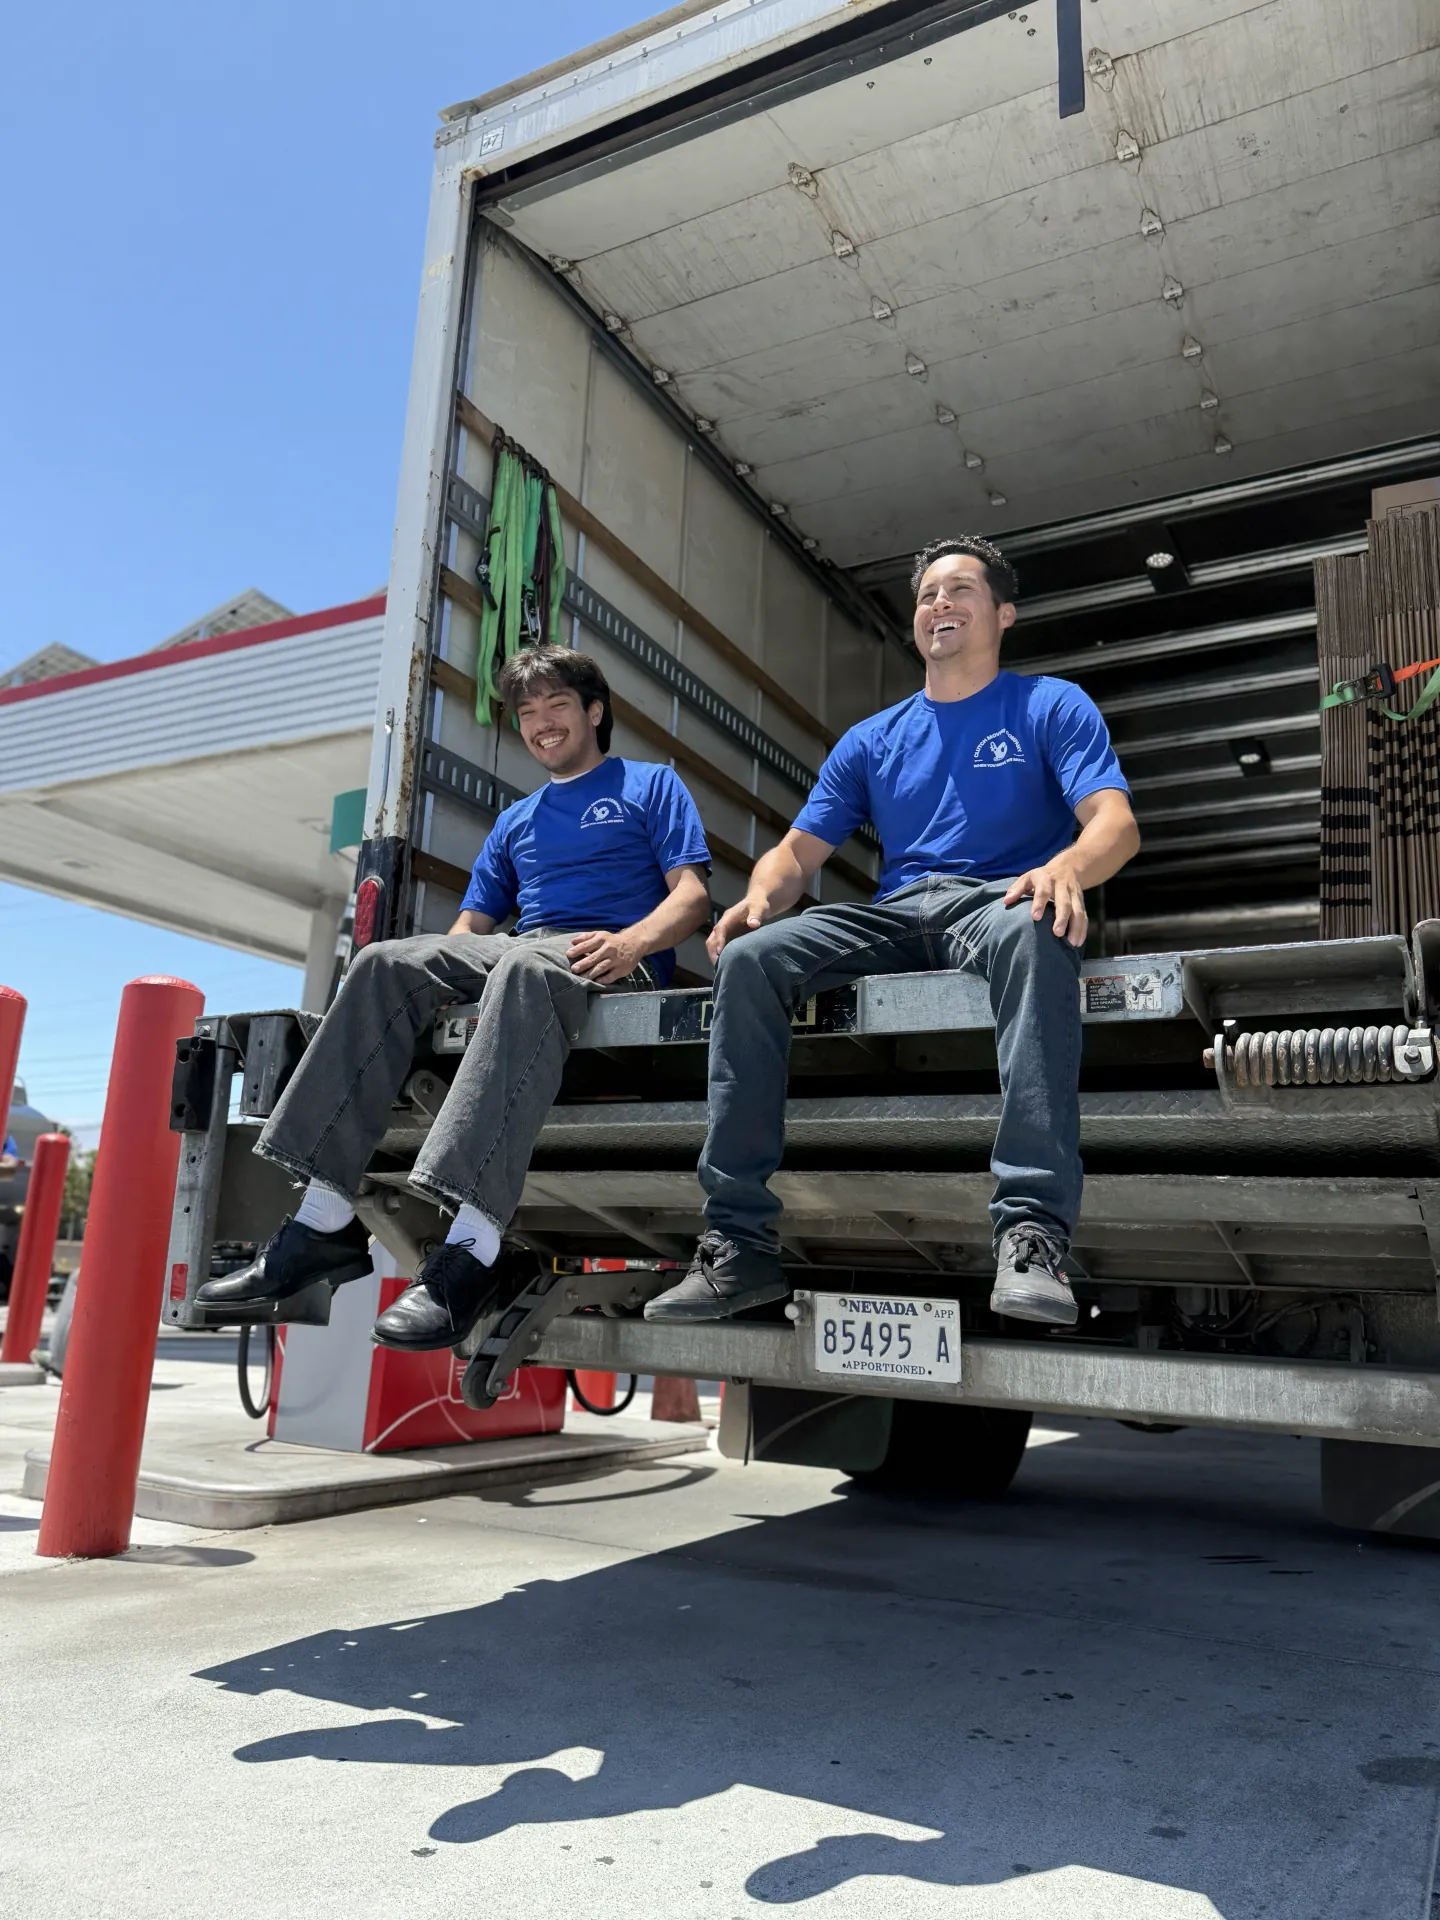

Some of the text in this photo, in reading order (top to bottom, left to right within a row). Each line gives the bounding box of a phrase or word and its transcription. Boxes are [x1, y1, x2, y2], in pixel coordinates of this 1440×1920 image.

[974, 738, 987, 758] CLUTCH
[849, 1300, 919, 1316] NEVADA
[934, 1309, 954, 1319] APP
[824, 1319, 950, 1363] 85495 A
[847, 1361, 926, 1376] APPORTIONED
